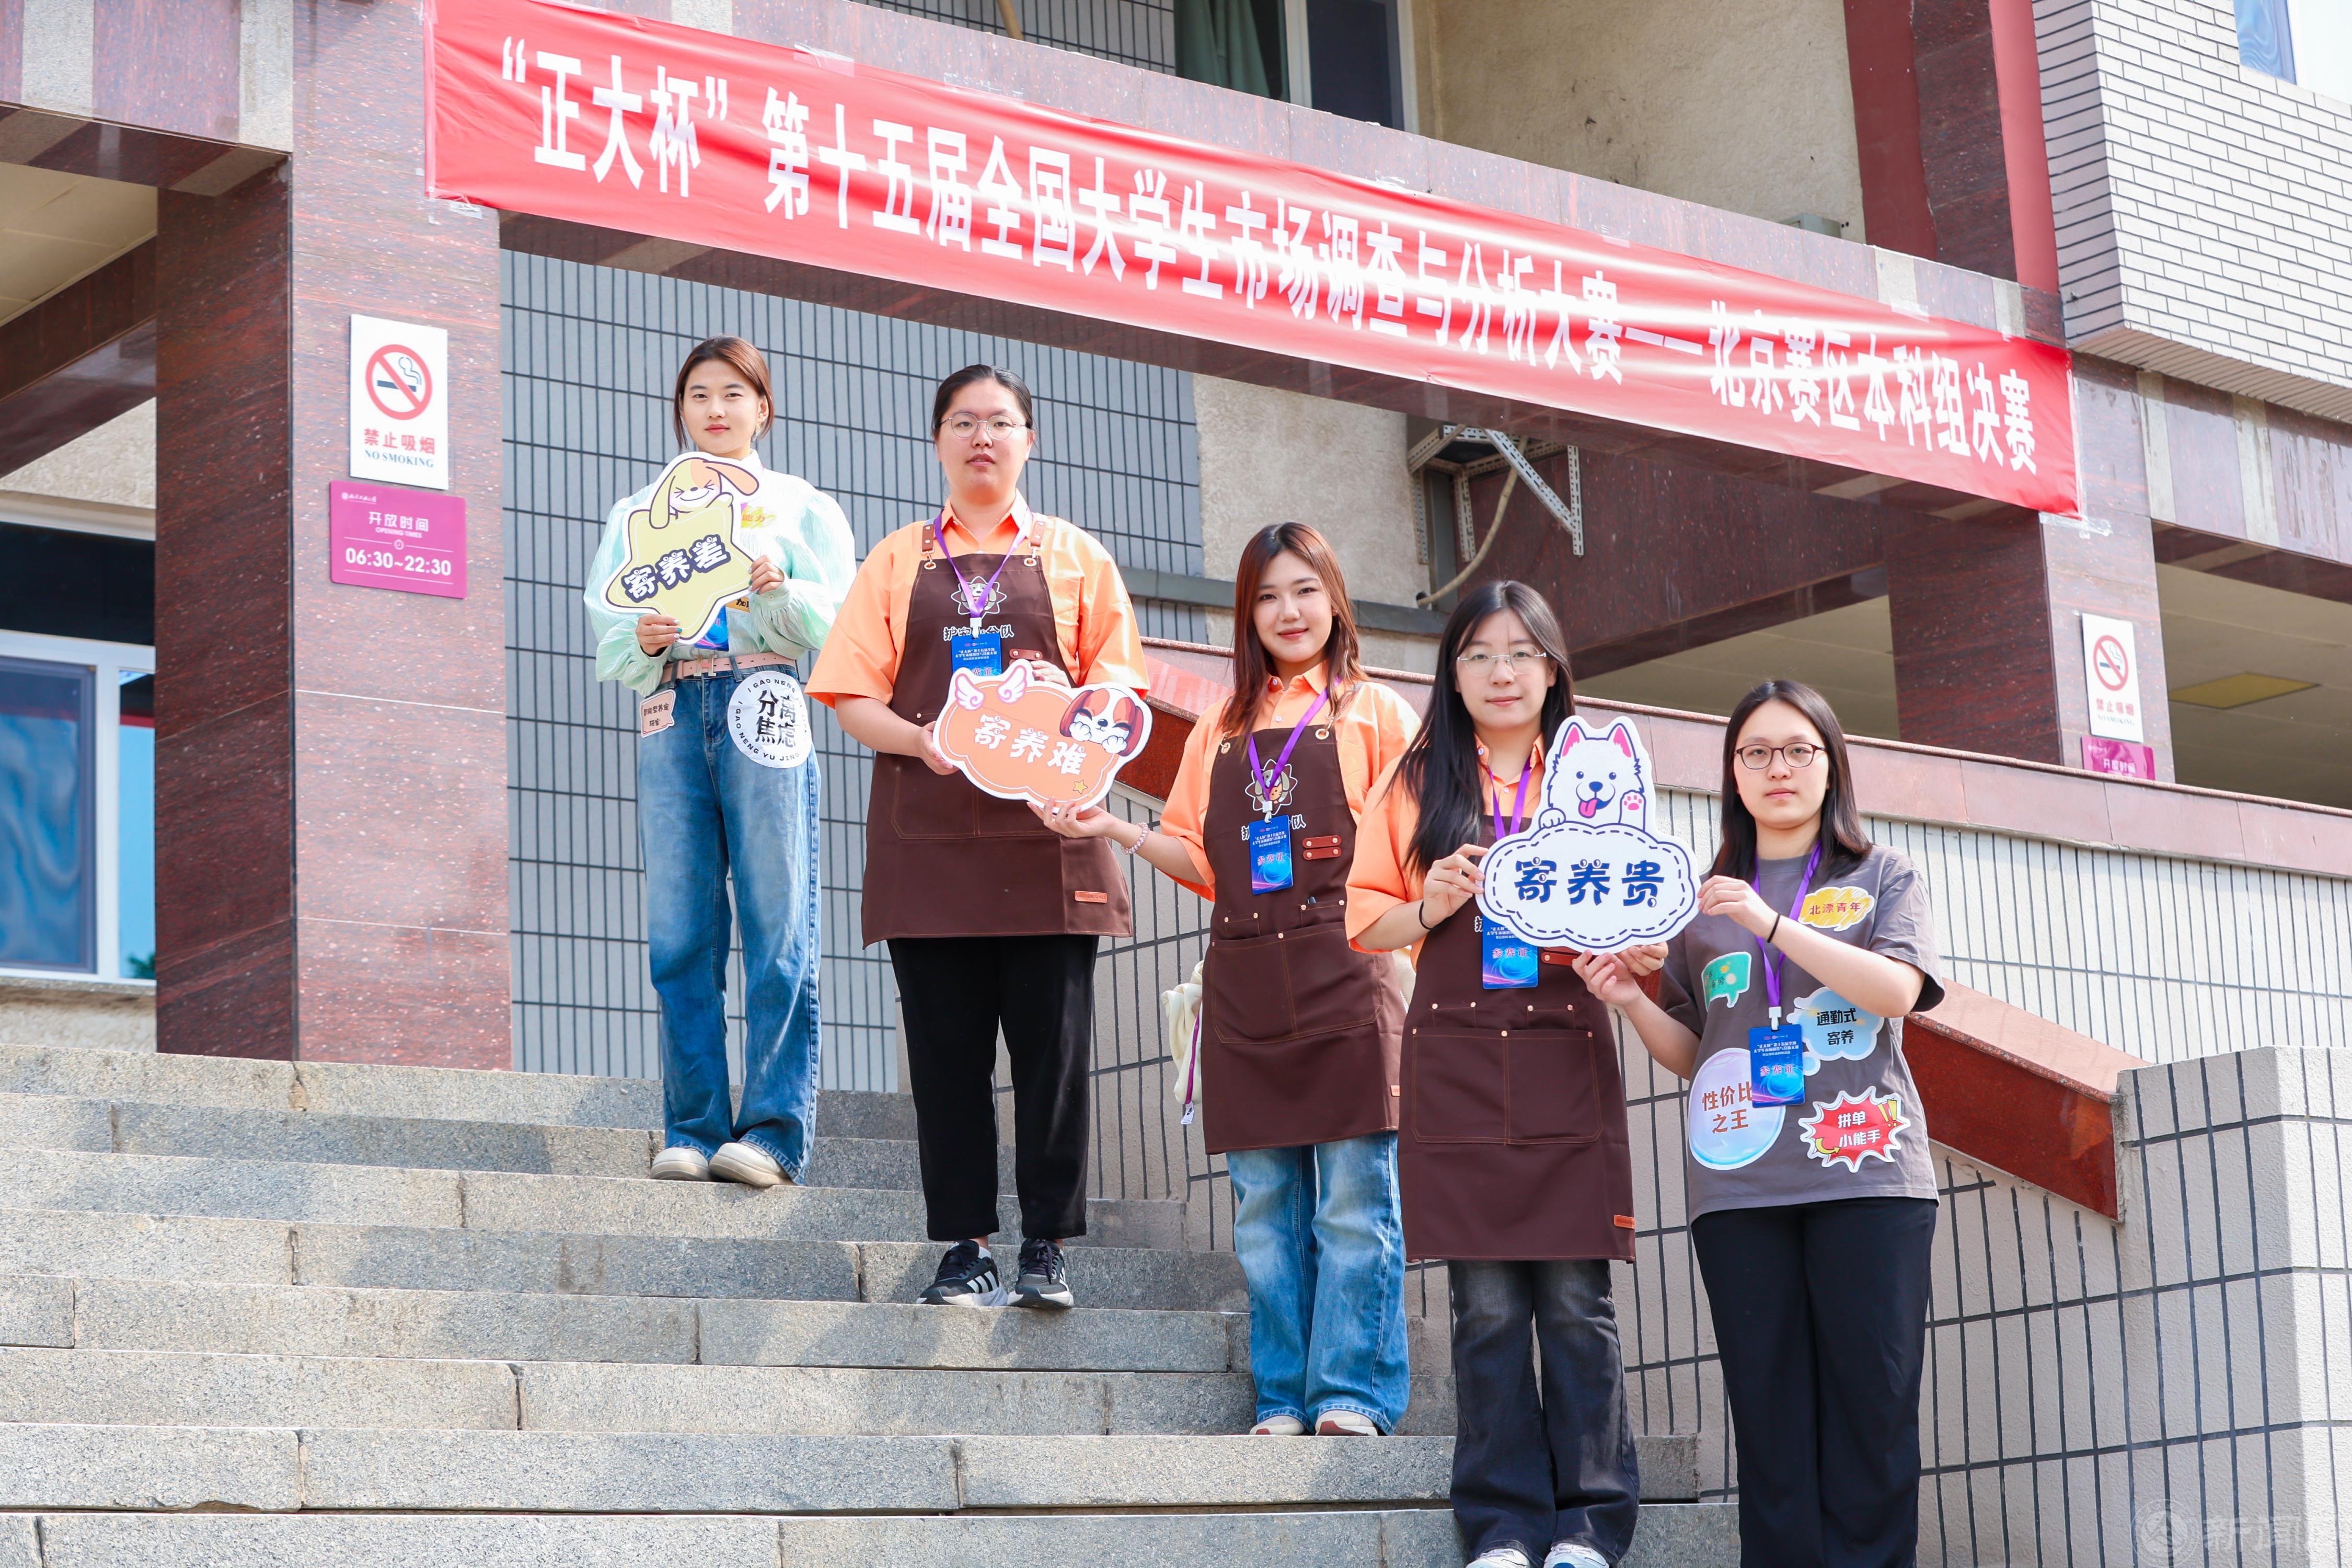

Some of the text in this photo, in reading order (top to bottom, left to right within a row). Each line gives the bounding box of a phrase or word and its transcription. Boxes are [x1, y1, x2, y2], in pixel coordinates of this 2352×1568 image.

[364, 428, 435, 455] 禁止吸烟
[365, 449, 434, 468] NO SMOKING
[368, 511, 429, 532] 开放时间
[622, 535, 729, 601] 寄养差
[753, 679, 771, 688] GAO
[739, 732, 759, 754] NENG
[779, 752, 800, 761] JING
[974, 713, 1087, 775] 寄养难
[1514, 856, 1665, 908] 寄养贵
[1809, 902, 1861, 916] 北漂青年
[1492, 947, 1529, 959] 参赛证
[1816, 1008, 1857, 1027] 通勤式
[1827, 1030, 1854, 1046] 寄养
[1760, 1063, 1795, 1077] 参赛证
[1702, 1081, 1753, 1112] 性价比
[1712, 1109, 1749, 1134] 之王
[1837, 1111, 1866, 1128] 拼单
[1839, 1129, 1881, 1148] 小能手
